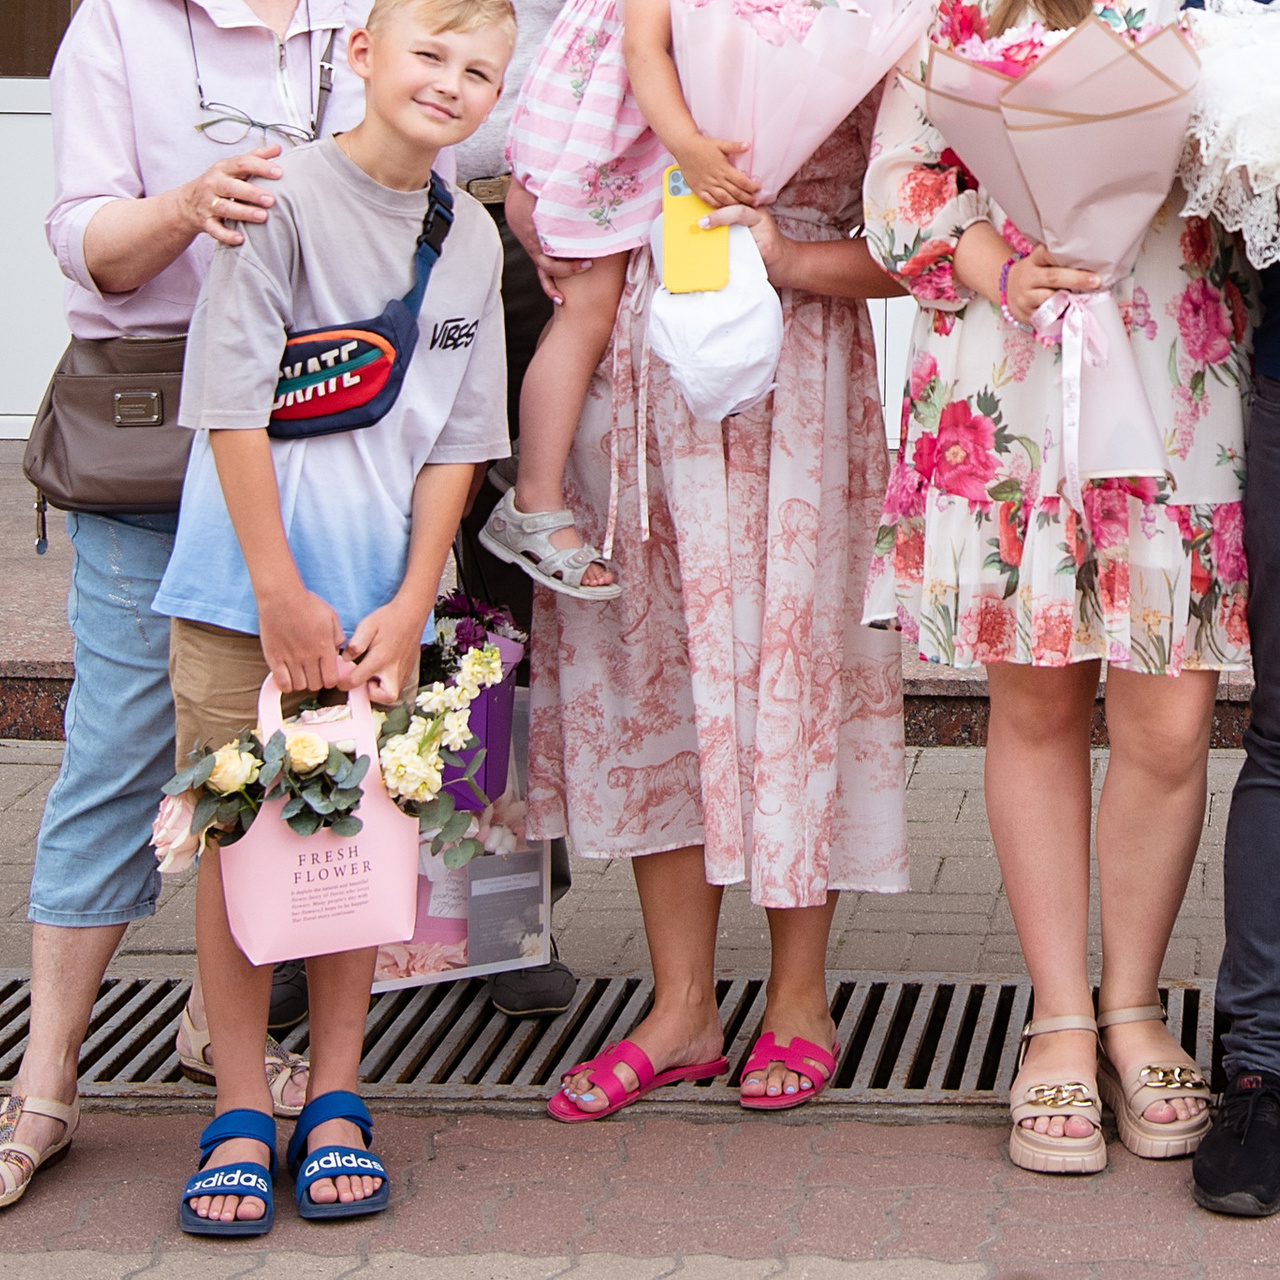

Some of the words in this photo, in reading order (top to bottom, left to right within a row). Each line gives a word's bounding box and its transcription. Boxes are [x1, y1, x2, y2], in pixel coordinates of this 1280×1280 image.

[429, 317, 480, 351] VIBES
[298, 845, 358, 866] FRESH
[294, 860, 372, 884] FLOWER
[303, 1152, 384, 1177] adidas
